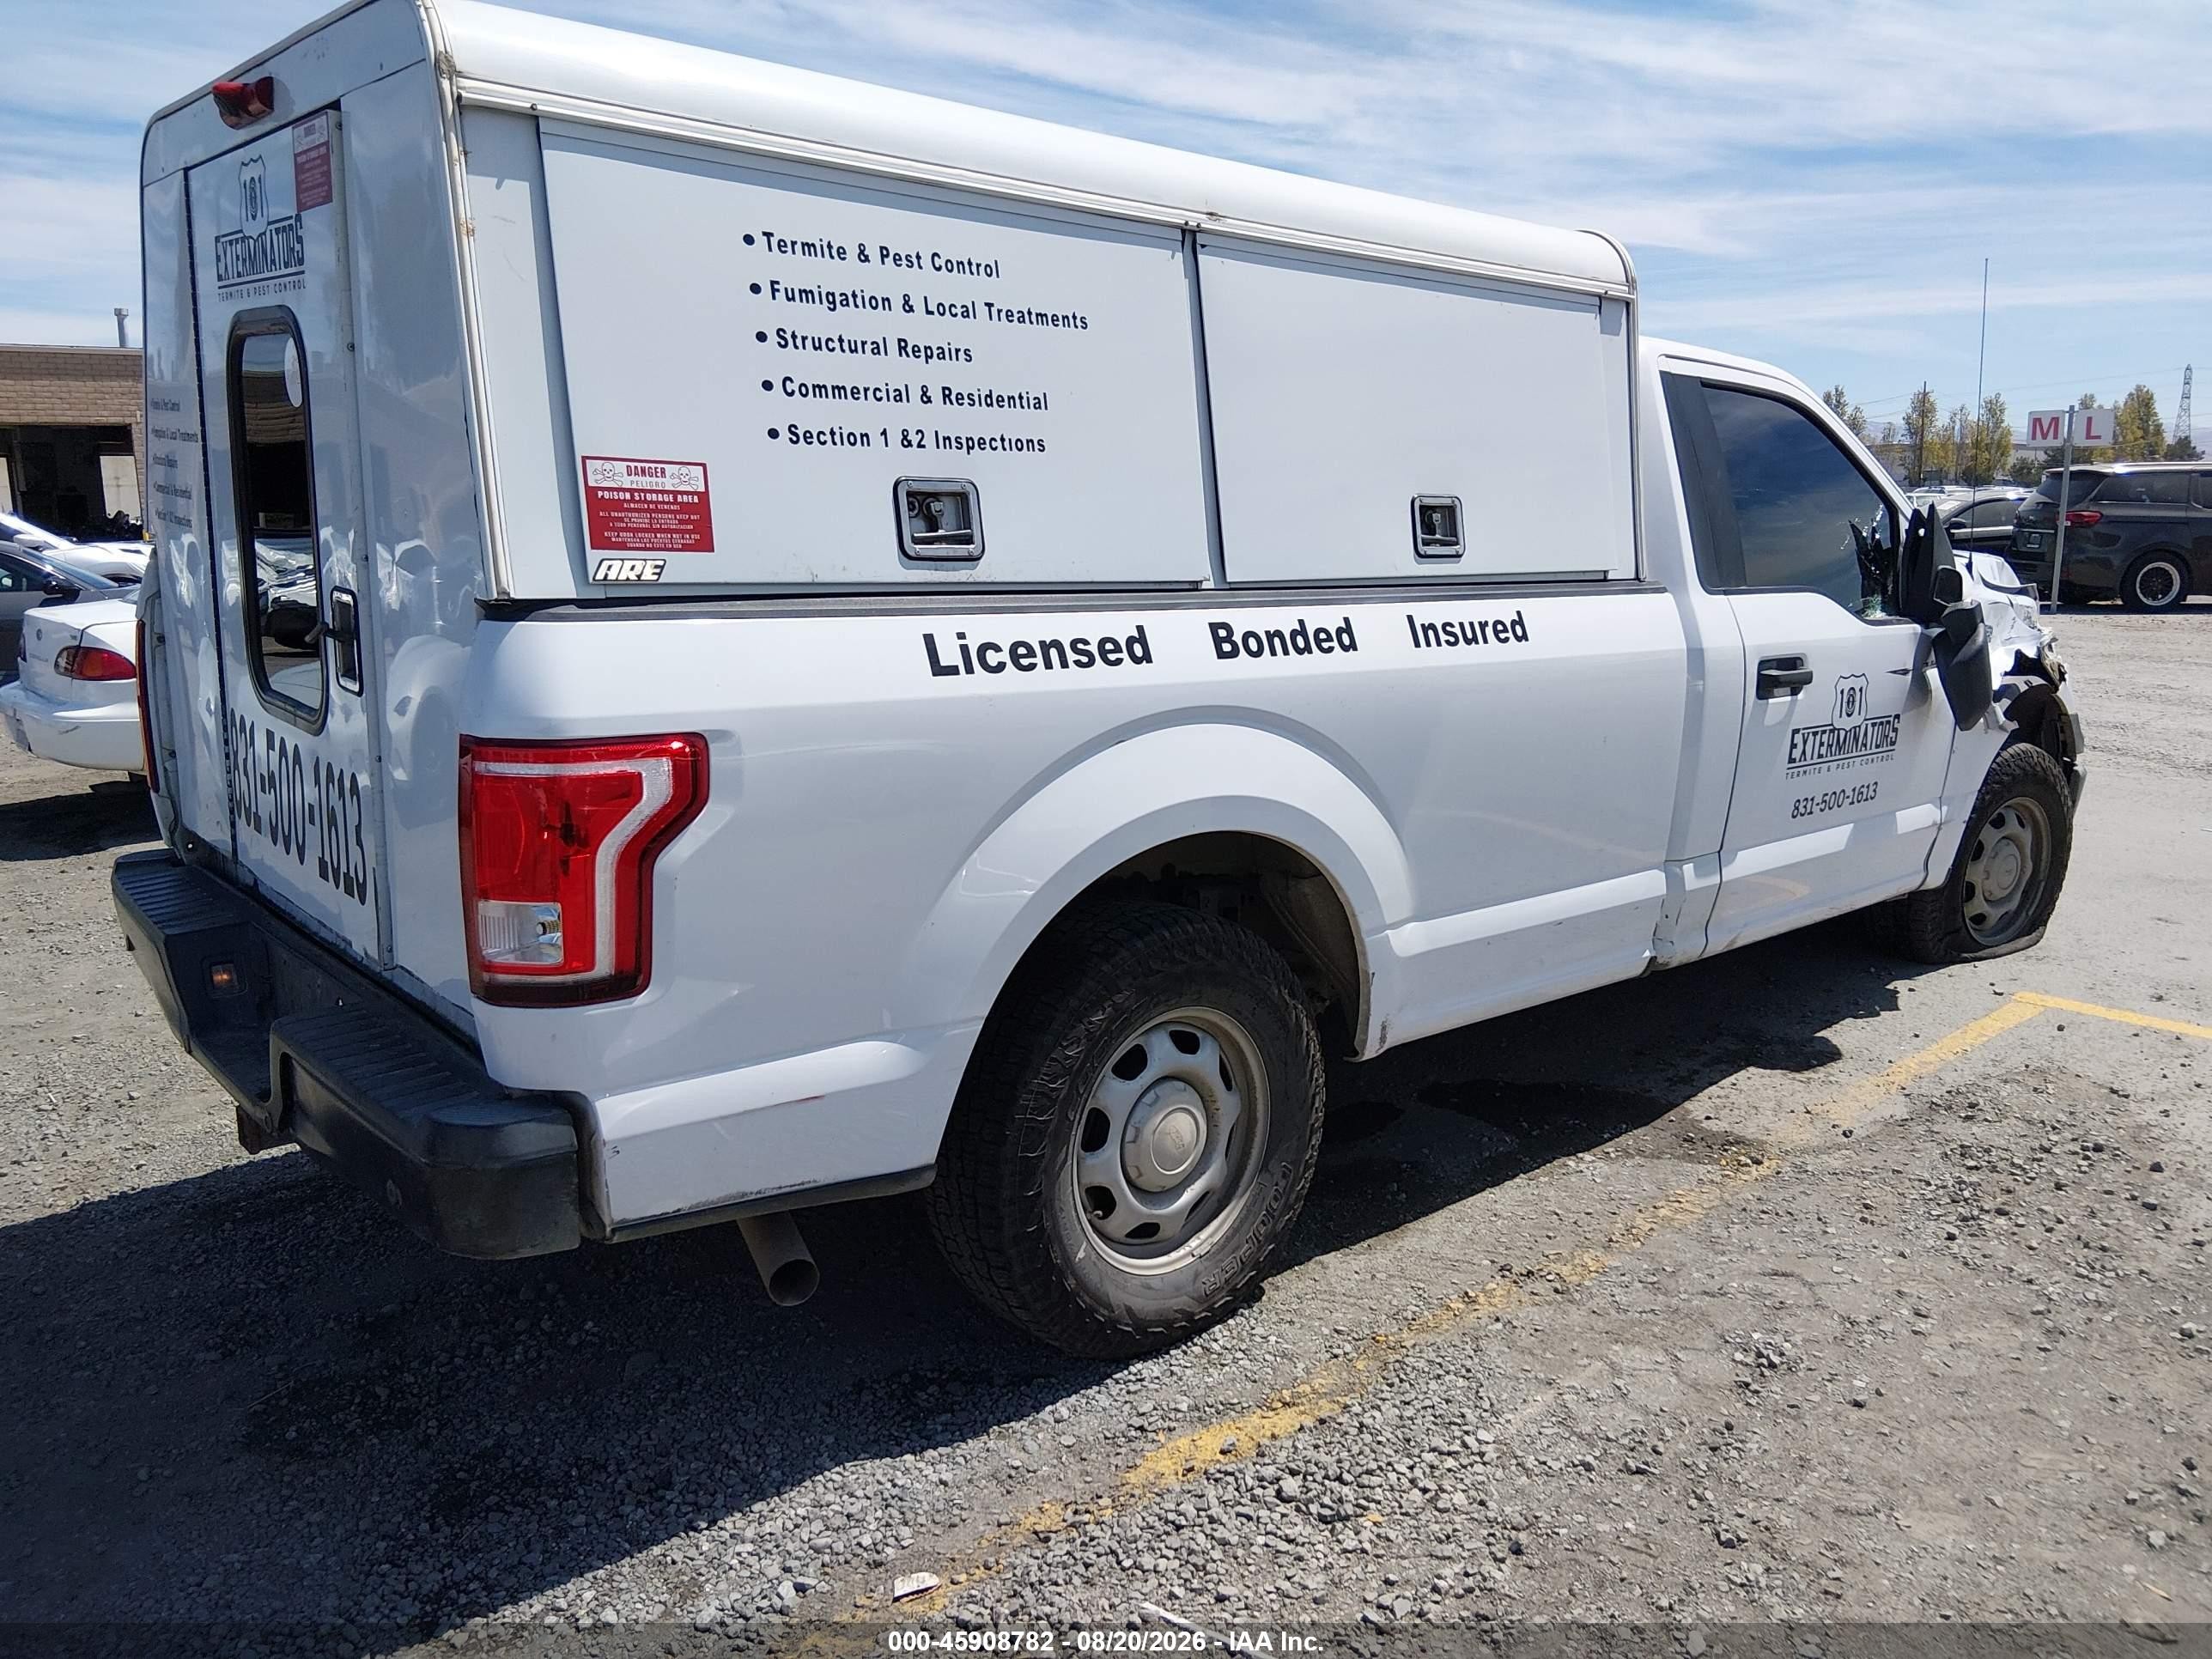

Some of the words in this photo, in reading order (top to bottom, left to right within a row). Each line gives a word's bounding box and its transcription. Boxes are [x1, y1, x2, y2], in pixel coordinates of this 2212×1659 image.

[243, 173, 264, 222] 101
[215, 213, 305, 283] EXTERMINATORS
[762, 231, 848, 261] Termite
[858, 243, 871, 264] &
[879, 246, 924, 270] Pest
[931, 252, 1000, 279] Control
[217, 289, 244, 302] TERMITE
[254, 284, 270, 296] PEST
[274, 278, 306, 294] CONTROL
[770, 280, 892, 313] Fumigation
[902, 294, 915, 314] &
[924, 295, 977, 320] Local
[984, 302, 1088, 331] Treatments
[776, 328, 889, 357] Structural
[897, 337, 973, 365] Repairs
[782, 376, 910, 404] Commercial
[921, 384, 933, 405] &
[941, 386, 1048, 411] Residential
[788, 424, 871, 447] Section
[880, 428, 889, 448] 1
[935, 430, 1046, 456] Inspections
[2032, 416, 2059, 441] M
[2086, 416, 2101, 440] L
[626, 465, 666, 479] DANGER
[630, 480, 666, 489] PELIGRO
[598, 490, 631, 501] POISON
[634, 492, 674, 502] STORAGE
[677, 495, 699, 503] AREA
[593, 559, 665, 581] ARE
[923, 625, 1153, 677] Licensed
[1208, 617, 1358, 660] Bonded
[1407, 611, 1529, 648] Insured
[1838, 686, 1863, 719] 101
[1787, 714, 1901, 764] EXTERMINATORS
[1785, 767, 1822, 780] TERMITE
[1836, 760, 1856, 770] PEST
[1860, 754, 1894, 767] CONTROL
[229, 707, 368, 906] 831-500-1613
[1790, 781, 1879, 819] 831-500-1613
